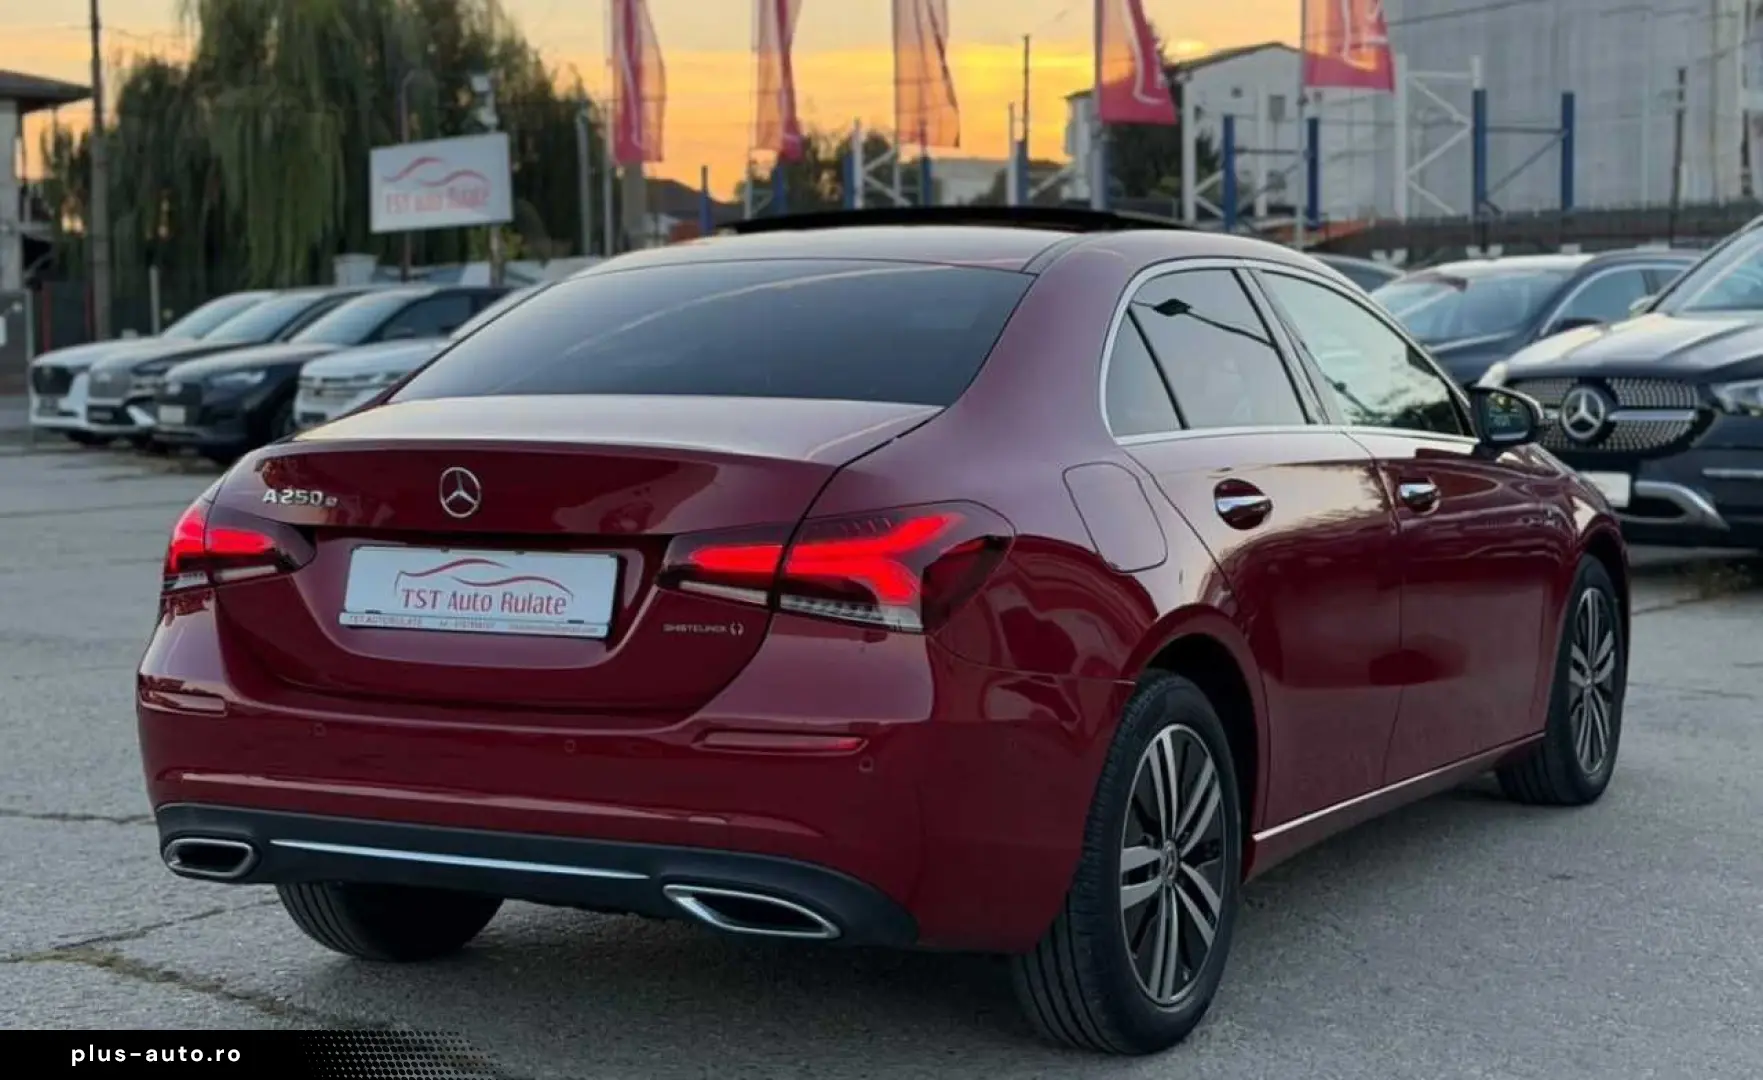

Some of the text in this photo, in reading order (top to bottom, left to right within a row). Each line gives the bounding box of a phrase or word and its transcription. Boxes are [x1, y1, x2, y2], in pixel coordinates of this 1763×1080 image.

[402, 588, 567, 615] TST Auto Rulate
